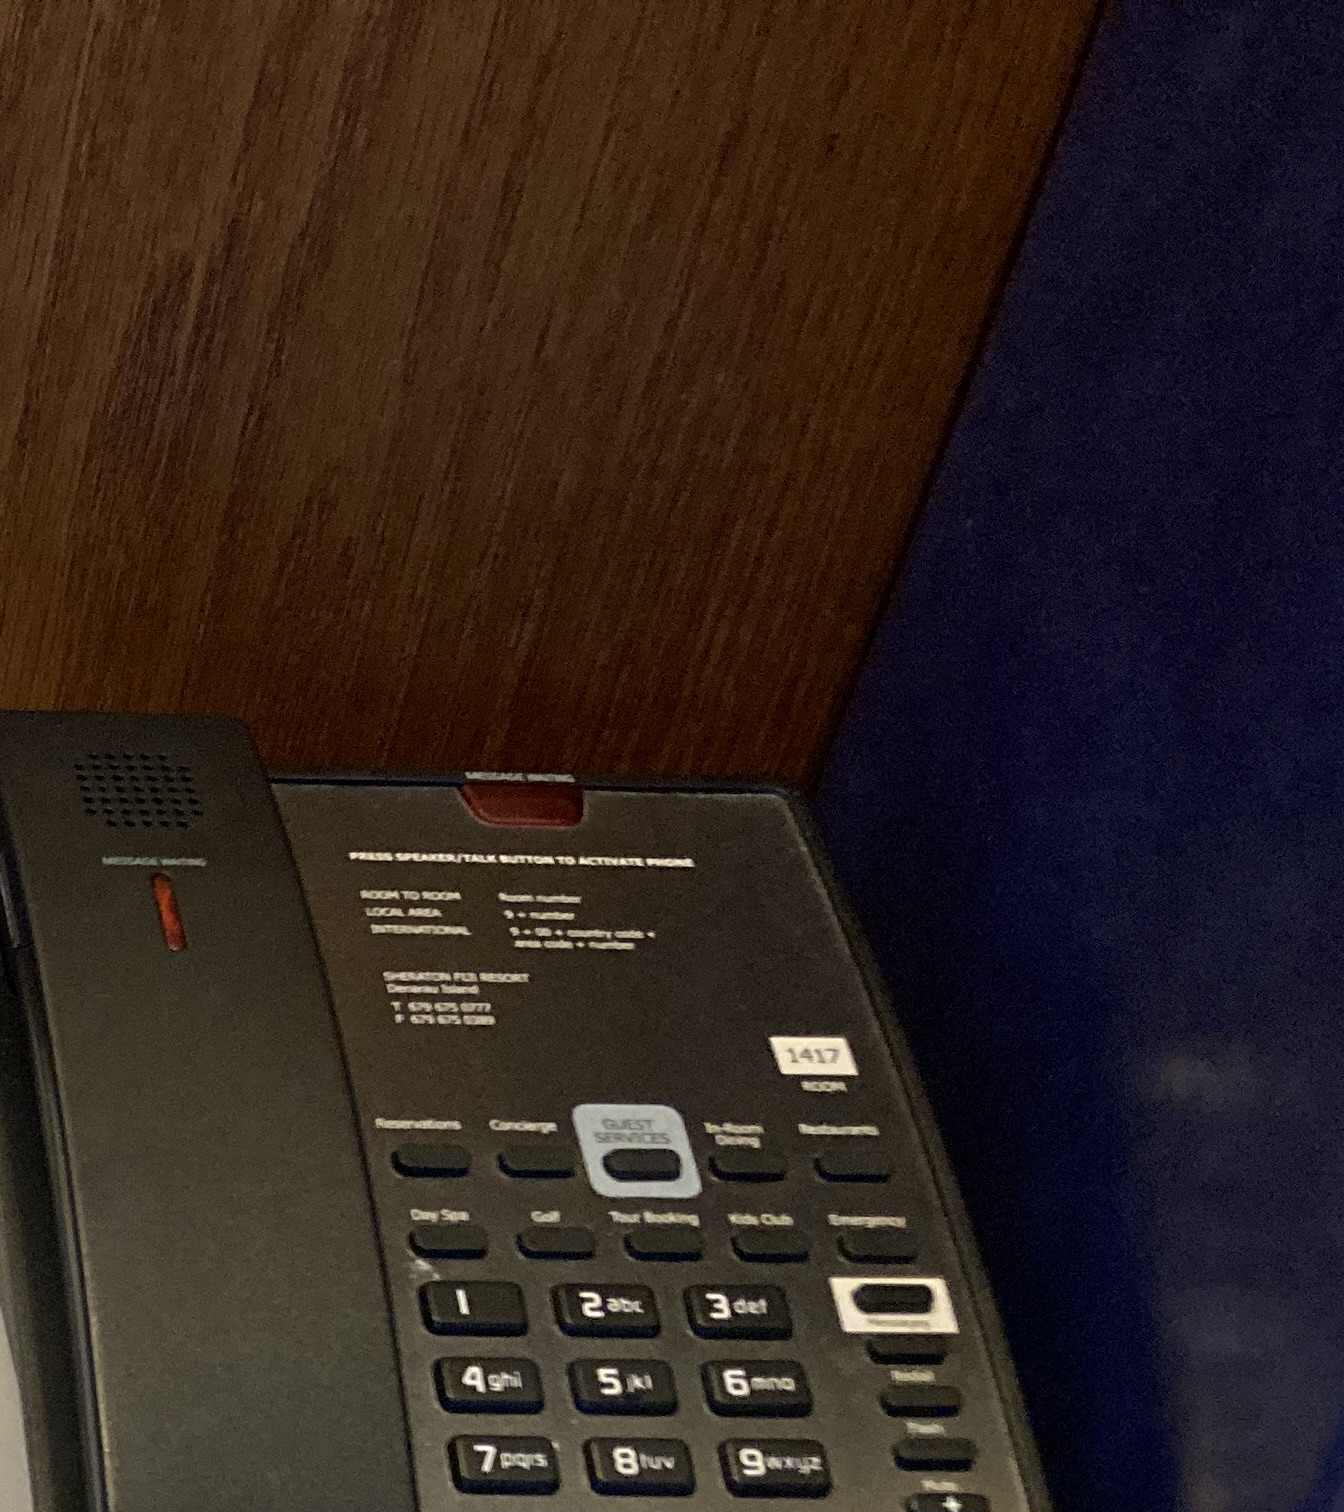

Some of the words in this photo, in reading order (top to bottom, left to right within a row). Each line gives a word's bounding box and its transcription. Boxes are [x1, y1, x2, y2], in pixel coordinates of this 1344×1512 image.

[555, 856, 576, 865] TO
[402, 891, 420, 900] TO
[785, 1047, 842, 1064] 1417
[601, 1118, 653, 1131] GUEST
[593, 1132, 672, 1144] SERVICES
[410, 1209, 439, 1222] Day
[440, 1209, 469, 1222] Spa
[531, 1211, 561, 1223] Golf
[761, 1214, 794, 1225] Club
[456, 1289, 470, 1314] 1
